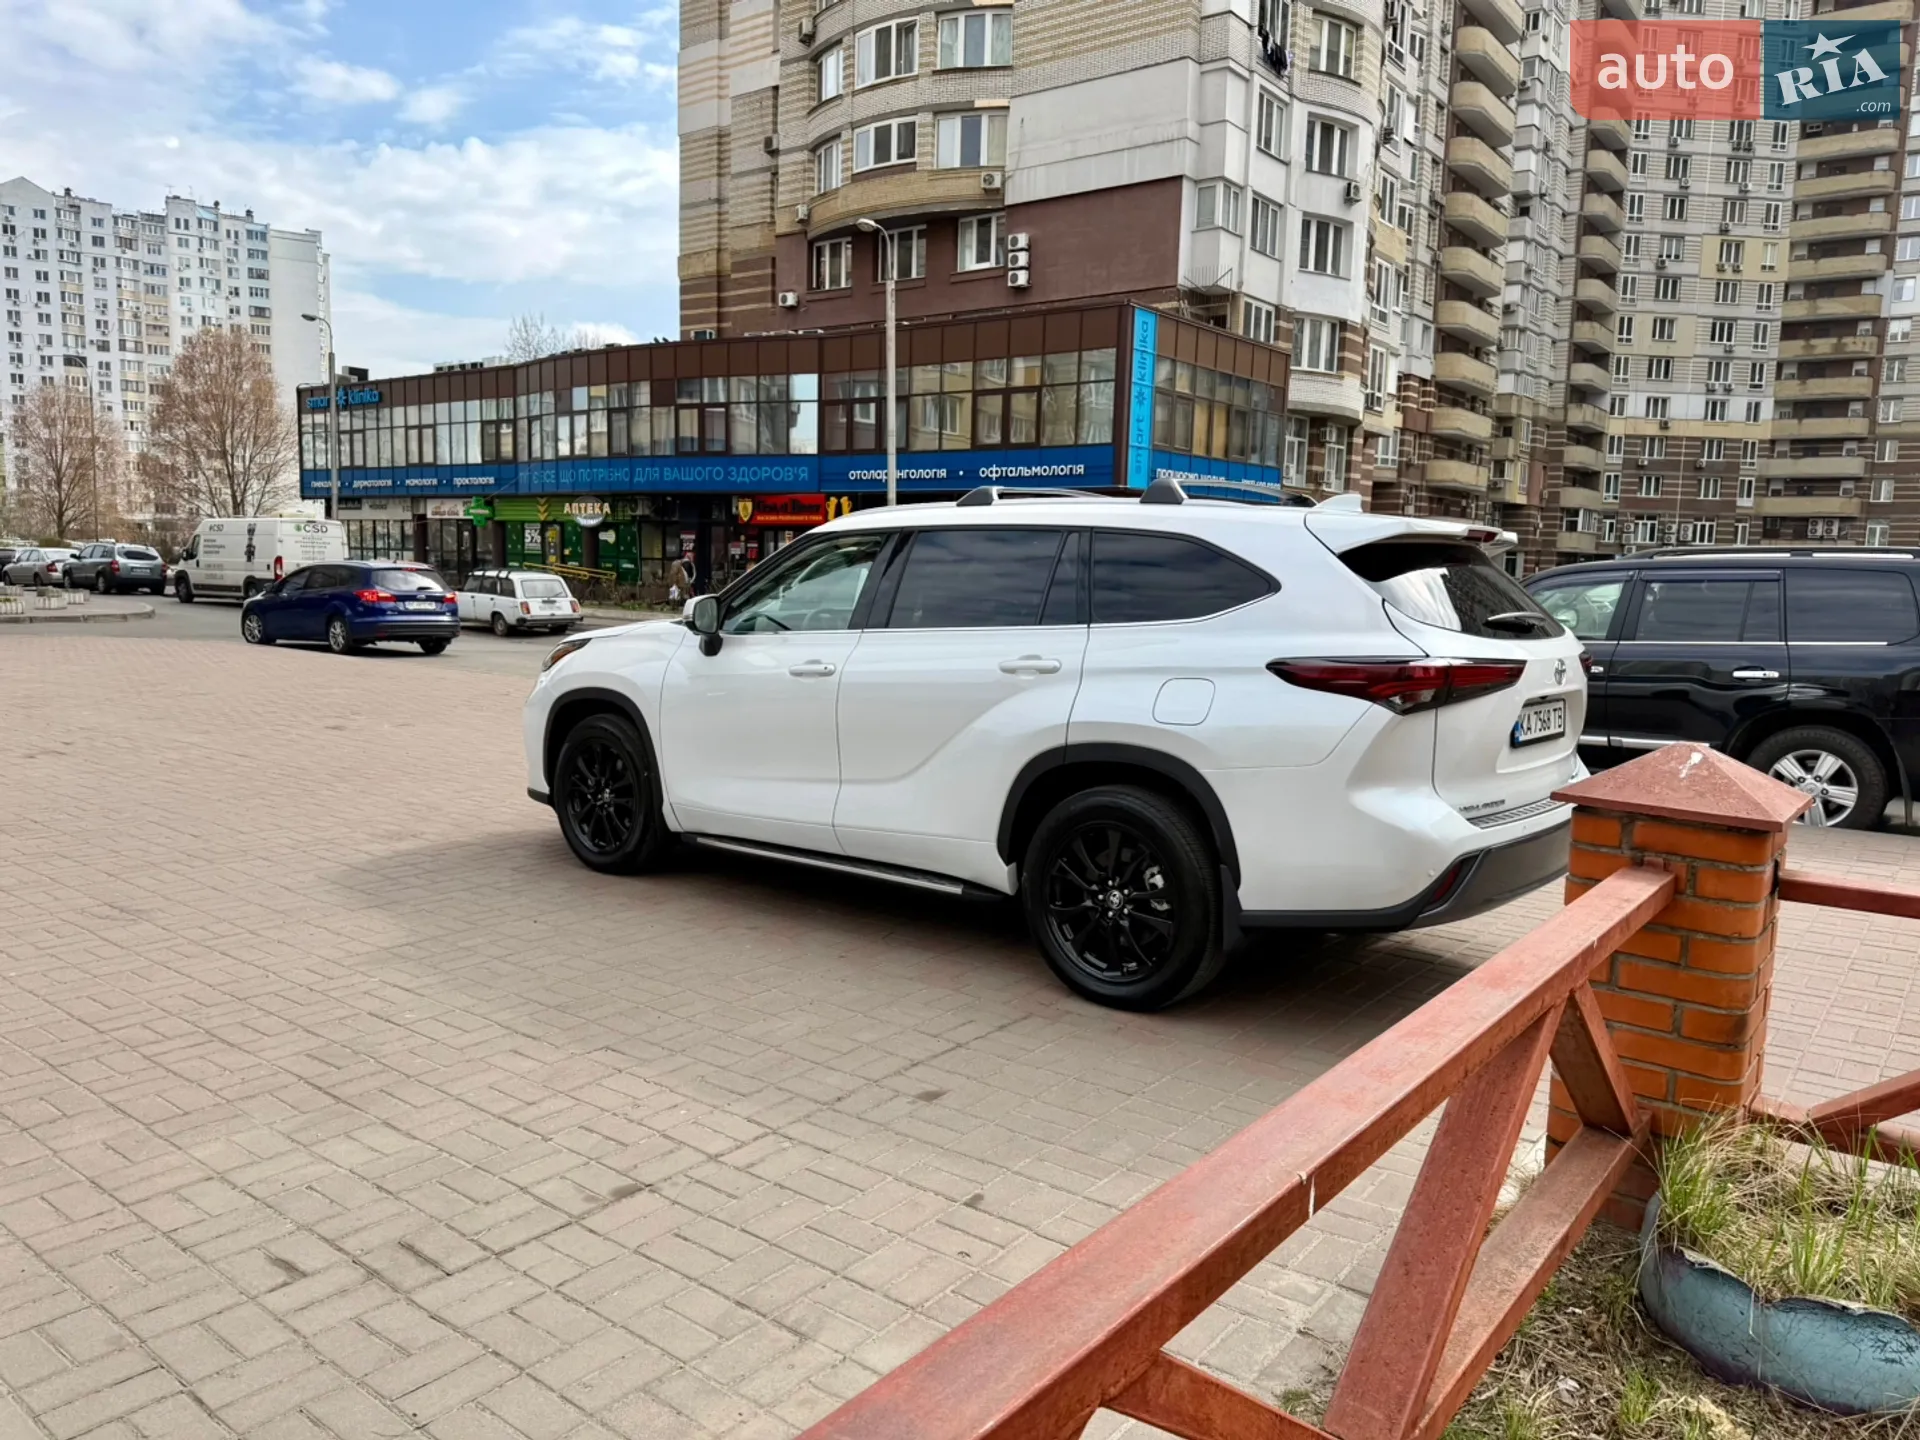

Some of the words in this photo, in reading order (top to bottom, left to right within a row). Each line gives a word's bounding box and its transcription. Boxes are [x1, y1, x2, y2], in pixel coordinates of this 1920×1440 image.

[1137, 320, 1149, 382] klinika
[306, 396, 330, 408] smar
[348, 387, 379, 404] klinika
[1134, 416, 1145, 474] smart
[560, 469, 576, 484] ЩО
[578, 467, 630, 482] ПОТРІБНО
[634, 467, 660, 484] ДЛЯ
[664, 466, 724, 482] ВАШОГО
[727, 466, 809, 484] ЗДОРОВ'Я
[848, 468, 947, 483] отоларнгологія
[979, 464, 1085, 481] офтальмологія
[563, 502, 611, 514] АПТЕКА
[303, 524, 328, 533] CSD
[524, 529, 541, 543] 5%
[1552, 707, 1562, 729] TB
